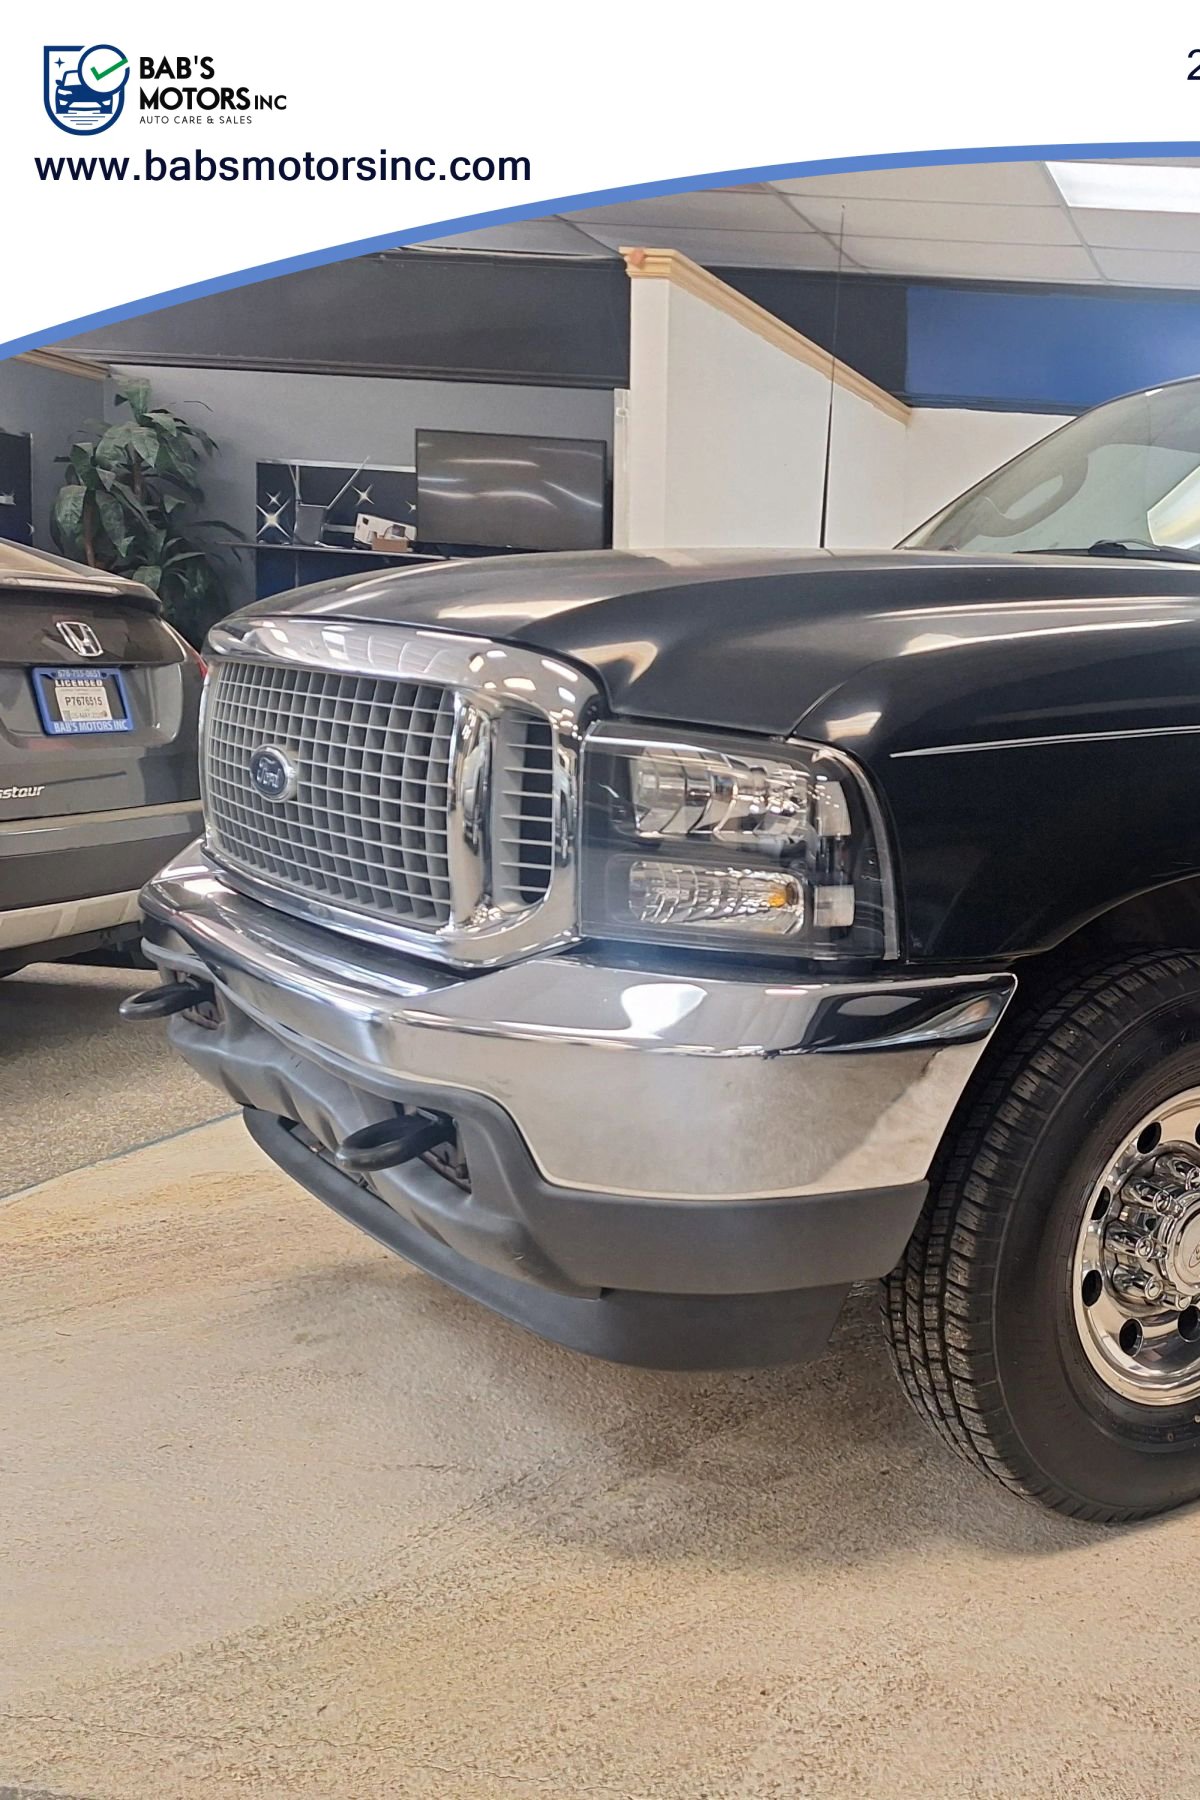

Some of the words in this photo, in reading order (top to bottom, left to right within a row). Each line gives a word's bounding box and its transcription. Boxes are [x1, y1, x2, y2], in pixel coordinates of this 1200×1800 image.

[53, 721, 78, 733] BAB'S
[79, 720, 113, 732] MOTORS
[113, 719, 129, 730] INC
